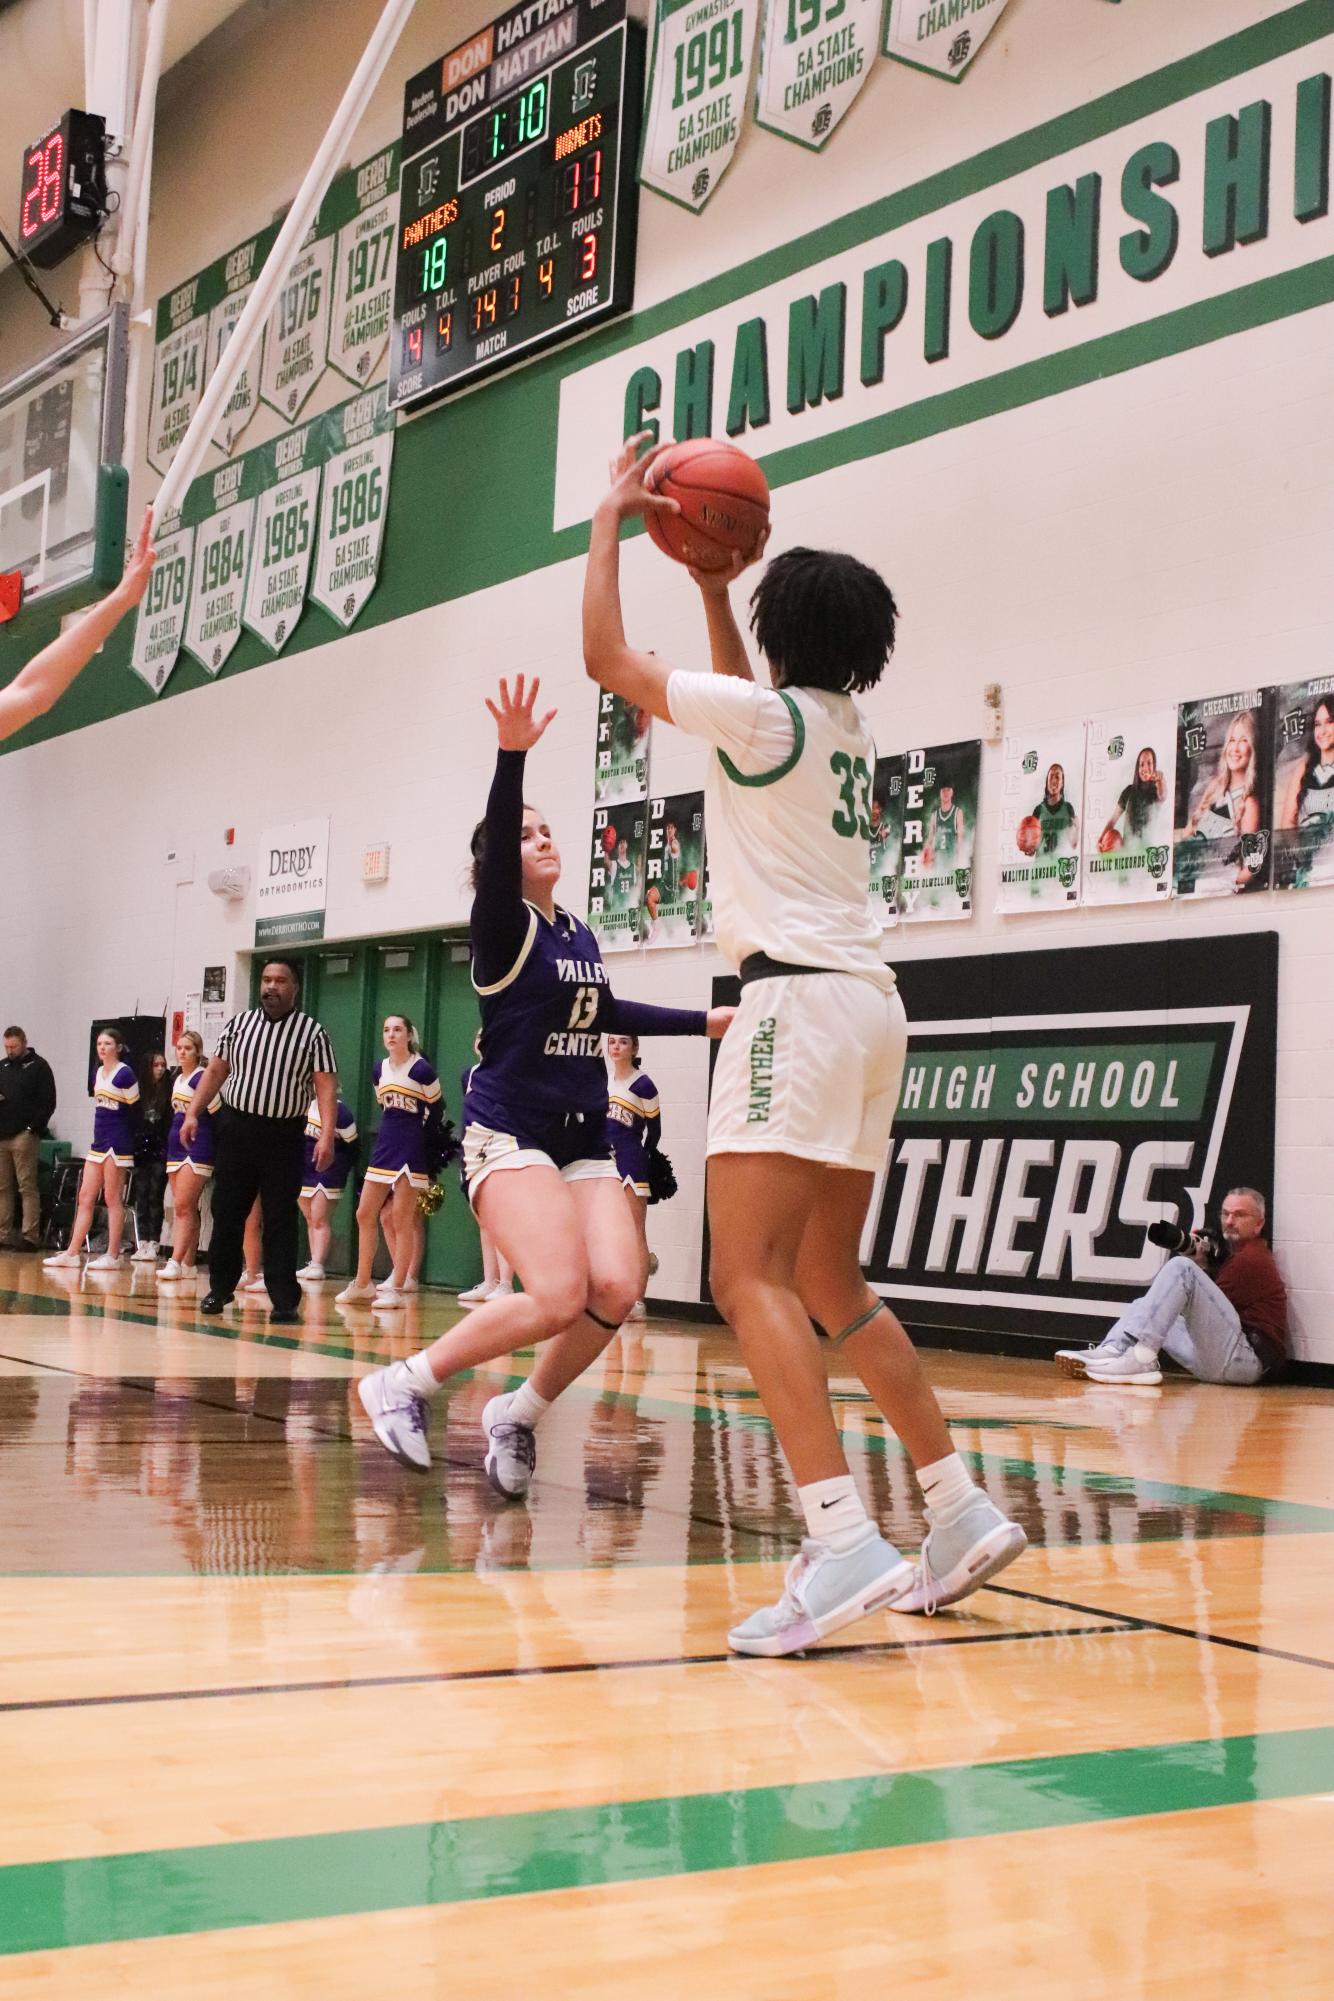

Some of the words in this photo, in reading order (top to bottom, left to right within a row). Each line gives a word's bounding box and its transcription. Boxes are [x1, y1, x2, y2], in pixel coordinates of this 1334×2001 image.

[450, 38, 487, 84] DON
[494, 16, 573, 90] HATTAN
[672, 8, 743, 110] 1991
[797, 50, 814, 78] 6A
[817, 22, 856, 66] STATE
[446, 75, 486, 123] DON
[784, 48, 864, 112] CHAMPIONS
[678, 114, 694, 142] 6A
[698, 93, 731, 133] STATE
[668, 117, 737, 174] CHAMPIONS
[484, 178, 516, 210] PERIOD
[403, 198, 458, 250] PANTHERS
[491, 209, 504, 251] 2
[571, 208, 603, 239] FOULS
[346, 223, 396, 303] 1977
[423, 238, 447, 292] 18
[468, 264, 500, 294] PLAYER
[504, 250, 526, 275] FOUL
[539, 259, 553, 294] 4
[582, 234, 596, 280] 3
[279, 268, 322, 341] 1976
[368, 289, 391, 318] STATE
[402, 303, 426, 328] FOULS
[476, 289, 496, 330] 14
[567, 285, 599, 317] SCORE
[292, 332, 311, 360] STATE
[342, 315, 390, 354] CHAMPIONS
[409, 328, 422, 361] 4
[439, 312, 451, 345] 4
[476, 330, 507, 360] MATCH
[161, 344, 198, 409] 1974
[276, 351, 314, 390] CHAMPIONS
[397, 375, 422, 398] SCORE
[172, 403, 190, 428] STATE
[329, 466, 383, 540] 1986
[262, 499, 309, 569] 1985
[336, 548, 346, 568] 6A
[348, 536, 370, 563] STATE
[201, 529, 245, 595] 1984
[268, 575, 278, 595] 6A
[278, 565, 299, 592] STATE
[328, 556, 375, 593] CHAMPIONS
[145, 556, 186, 617] 1978
[206, 599, 215, 620] 6A
[216, 592, 235, 616] STATE
[260, 586, 302, 619] CHAMPIONS
[158, 615, 177, 638] STATE
[200, 611, 238, 642] CHAMPIONS
[145, 634, 179, 663] CHAMPIONS
[1203, 692, 1263, 717] CHEERLEADING
[269, 845, 317, 878] DERBY
[259, 878, 323, 897] ORTHODONTICS
[567, 987, 599, 1029] 13
[746, 1017, 776, 1123] PANTHERS
[902, 1064, 996, 1110] HIGH
[1016, 1060, 1179, 1109] SCHOOL
